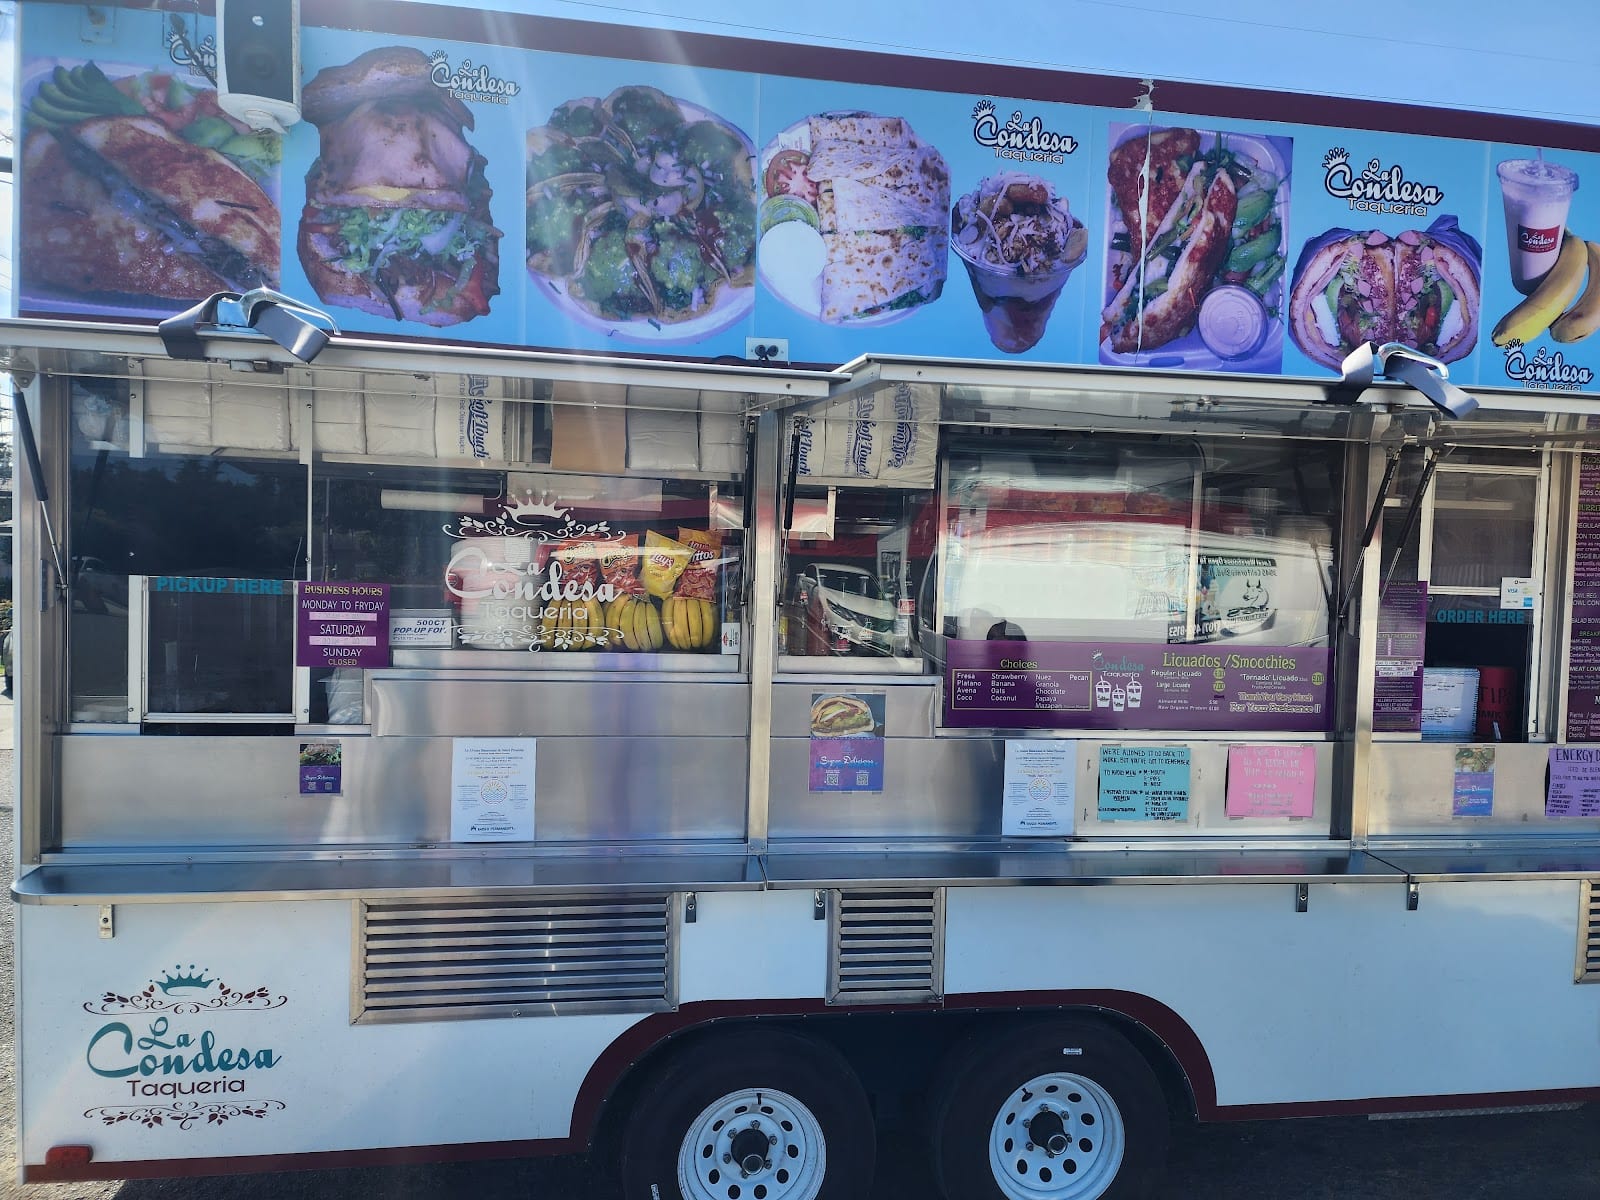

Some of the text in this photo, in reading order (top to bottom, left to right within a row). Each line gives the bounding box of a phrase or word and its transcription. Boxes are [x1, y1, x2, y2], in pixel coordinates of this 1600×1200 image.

[459, 59, 480, 77] La
[431, 62, 520, 96] Condesa
[448, 88, 508, 105] Taqueria
[1006, 111, 1031, 132] La
[974, 113, 1078, 154] Condesa
[994, 146, 1064, 164] Taqueria
[1362, 159, 1391, 182] La
[1325, 162, 1444, 205] Condesa
[1346, 197, 1428, 216] Taqueria
[1521, 232, 1555, 245] Condesa
[1533, 346, 1554, 365] La
[1506, 351, 1594, 384] Condesa
[1521, 380, 1582, 391] Taqueria
[1581, 456, 1600, 464] ACOS
[691, 551, 714, 563] ritos
[445, 547, 624, 602] Condesa
[157, 577, 284, 595] PICKUP HERE
[304, 585, 383, 597] BUSINESS HOURS
[302, 600, 384, 612] MONDAY TO FRYDAY
[480, 601, 588, 621] Taqueria
[1437, 609, 1525, 624] ORDER HERE
[320, 624, 367, 637] SATURDAY
[323, 649, 363, 658] SUNDAY
[1162, 652, 1221, 668] Licuados
[328, 659, 358, 667] CLOSED
[1000, 659, 1038, 669] Choices
[1093, 655, 1145, 671] Condesa
[991, 673, 1028, 682] Strawberry
[1151, 669, 1176, 678] Regular
[1272, 674, 1299, 682] Licuado
[1156, 681, 1171, 689] Large
[1035, 695, 1057, 703] Papaya
[1230, 702, 1246, 712] For
[1247, 703, 1269, 713] Your
[1269, 703, 1313, 714] Preference
[1556, 748, 1593, 763] ENERGY
[137, 1016, 195, 1050] La
[87, 1022, 282, 1078] Condesa
[127, 1076, 245, 1098] Taqueria
